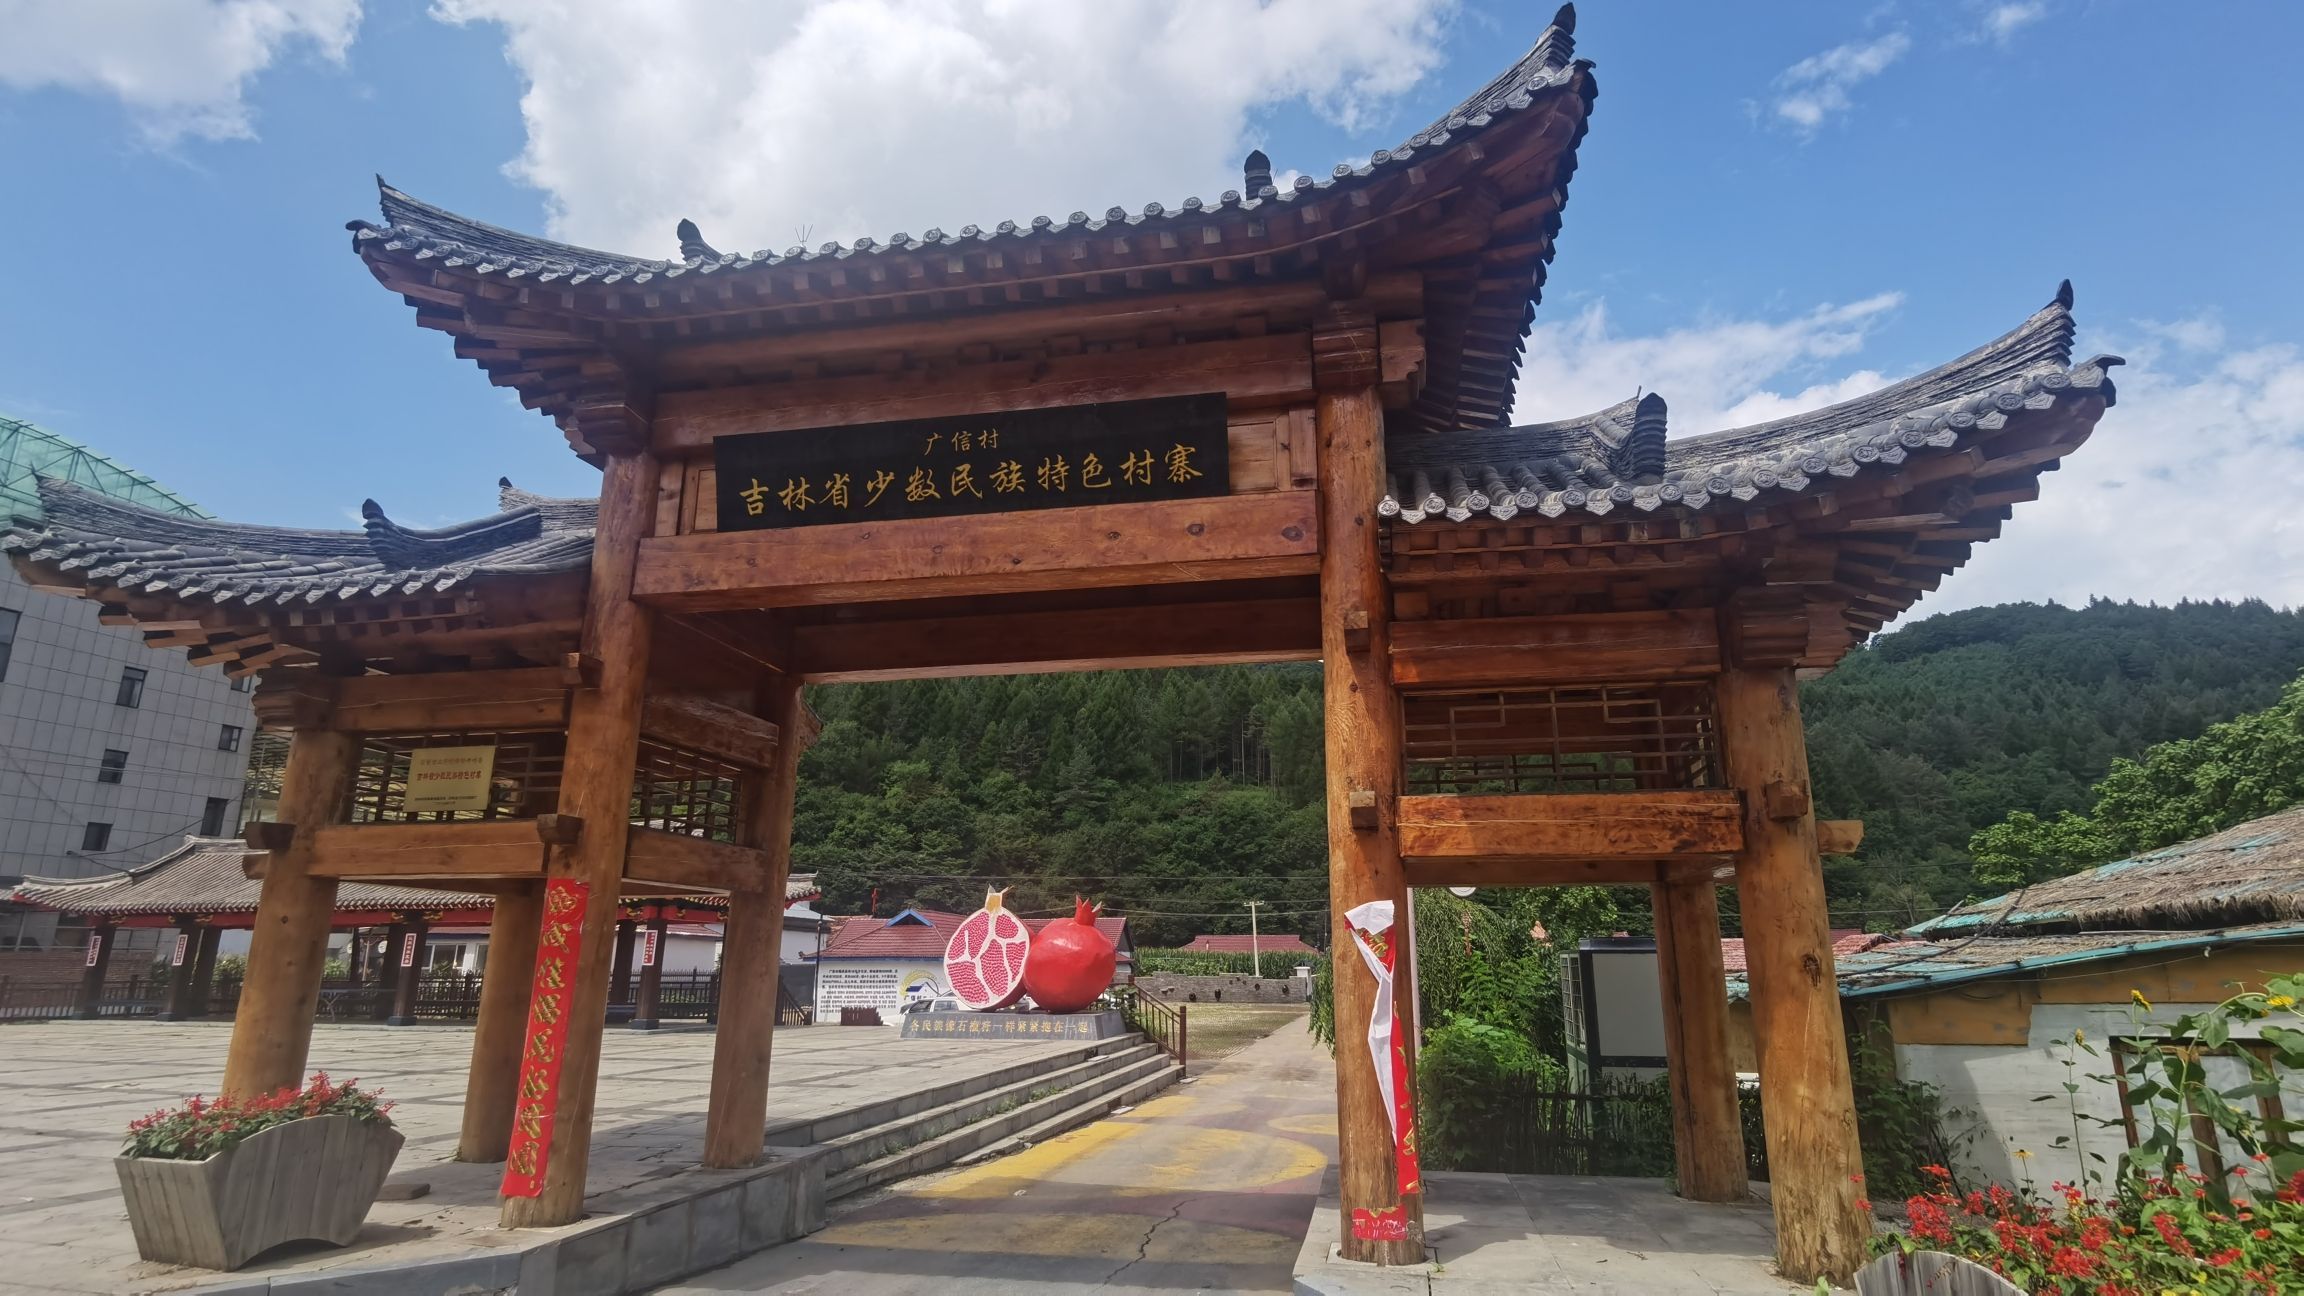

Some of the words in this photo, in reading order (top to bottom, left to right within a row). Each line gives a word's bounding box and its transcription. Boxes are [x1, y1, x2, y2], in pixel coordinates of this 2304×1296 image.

[924, 429, 999, 456] 广信村
[739, 443, 1203, 516] 吉林省少数民族特色村寨
